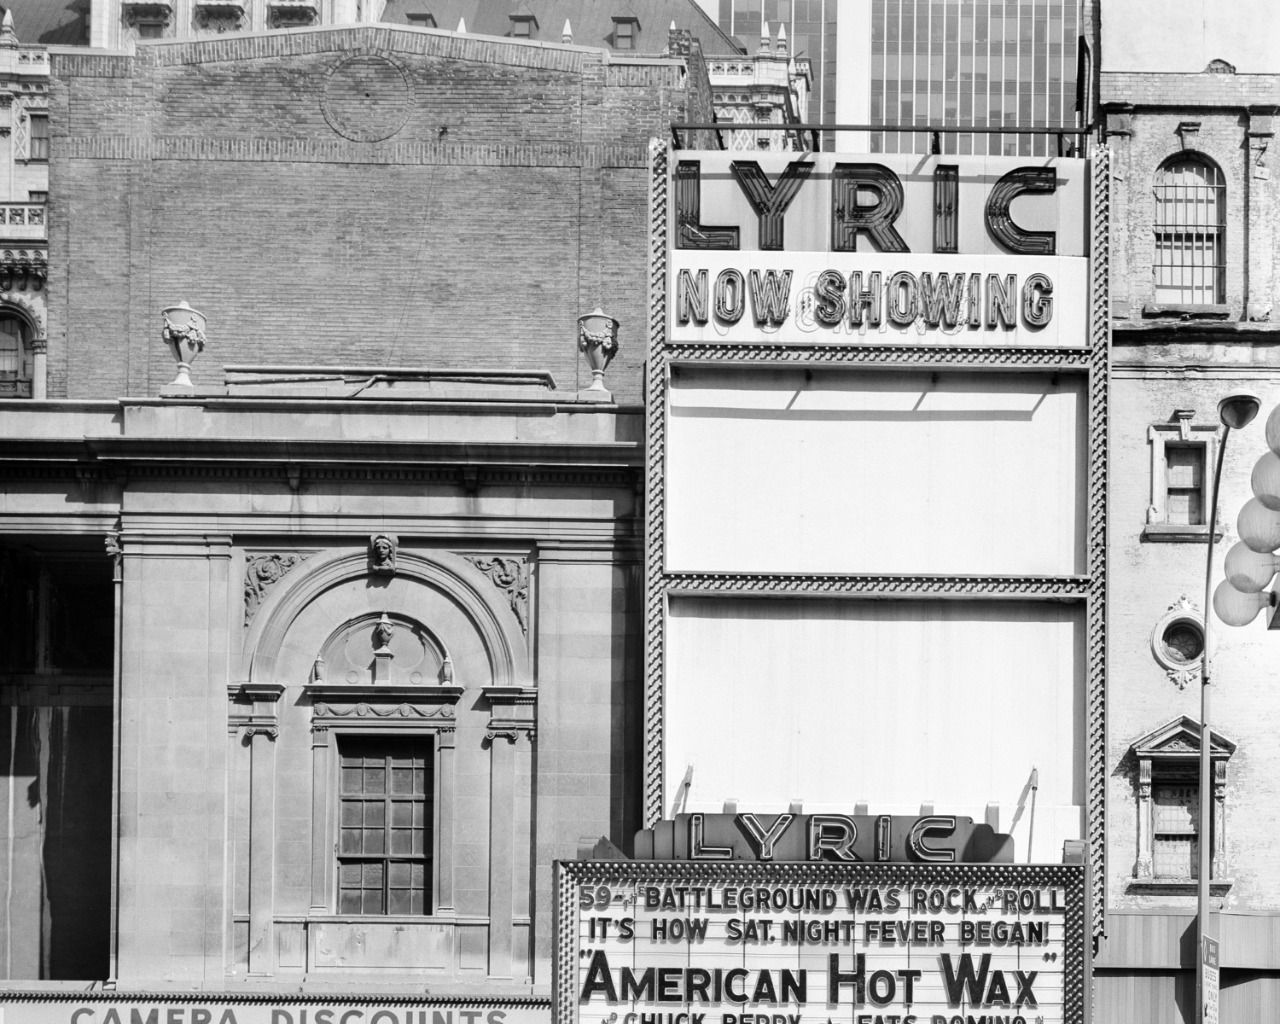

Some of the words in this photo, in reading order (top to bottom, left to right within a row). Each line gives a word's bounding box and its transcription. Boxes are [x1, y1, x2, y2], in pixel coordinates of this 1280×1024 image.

[675, 159, 1057, 255] LYRIC
[678, 267, 794, 326] NOW
[814, 268, 1054, 330] SHOWING
[690, 813, 957, 861] LYRIC
[646, 886, 837, 910] BATTLEGROUND
[845, 888, 901, 911] WAS
[912, 888, 978, 911] ROCK
[1003, 888, 1066, 912] ROLL
[590, 917, 634, 939] IT'S
[652, 918, 709, 941] HOW
[726, 918, 776, 942] SAT.
[784, 919, 856, 942] NIGHT
[865, 920, 945, 943] FEVER
[960, 920, 1050, 944] BEGAN!
[828, 952, 922, 1005] HOT
